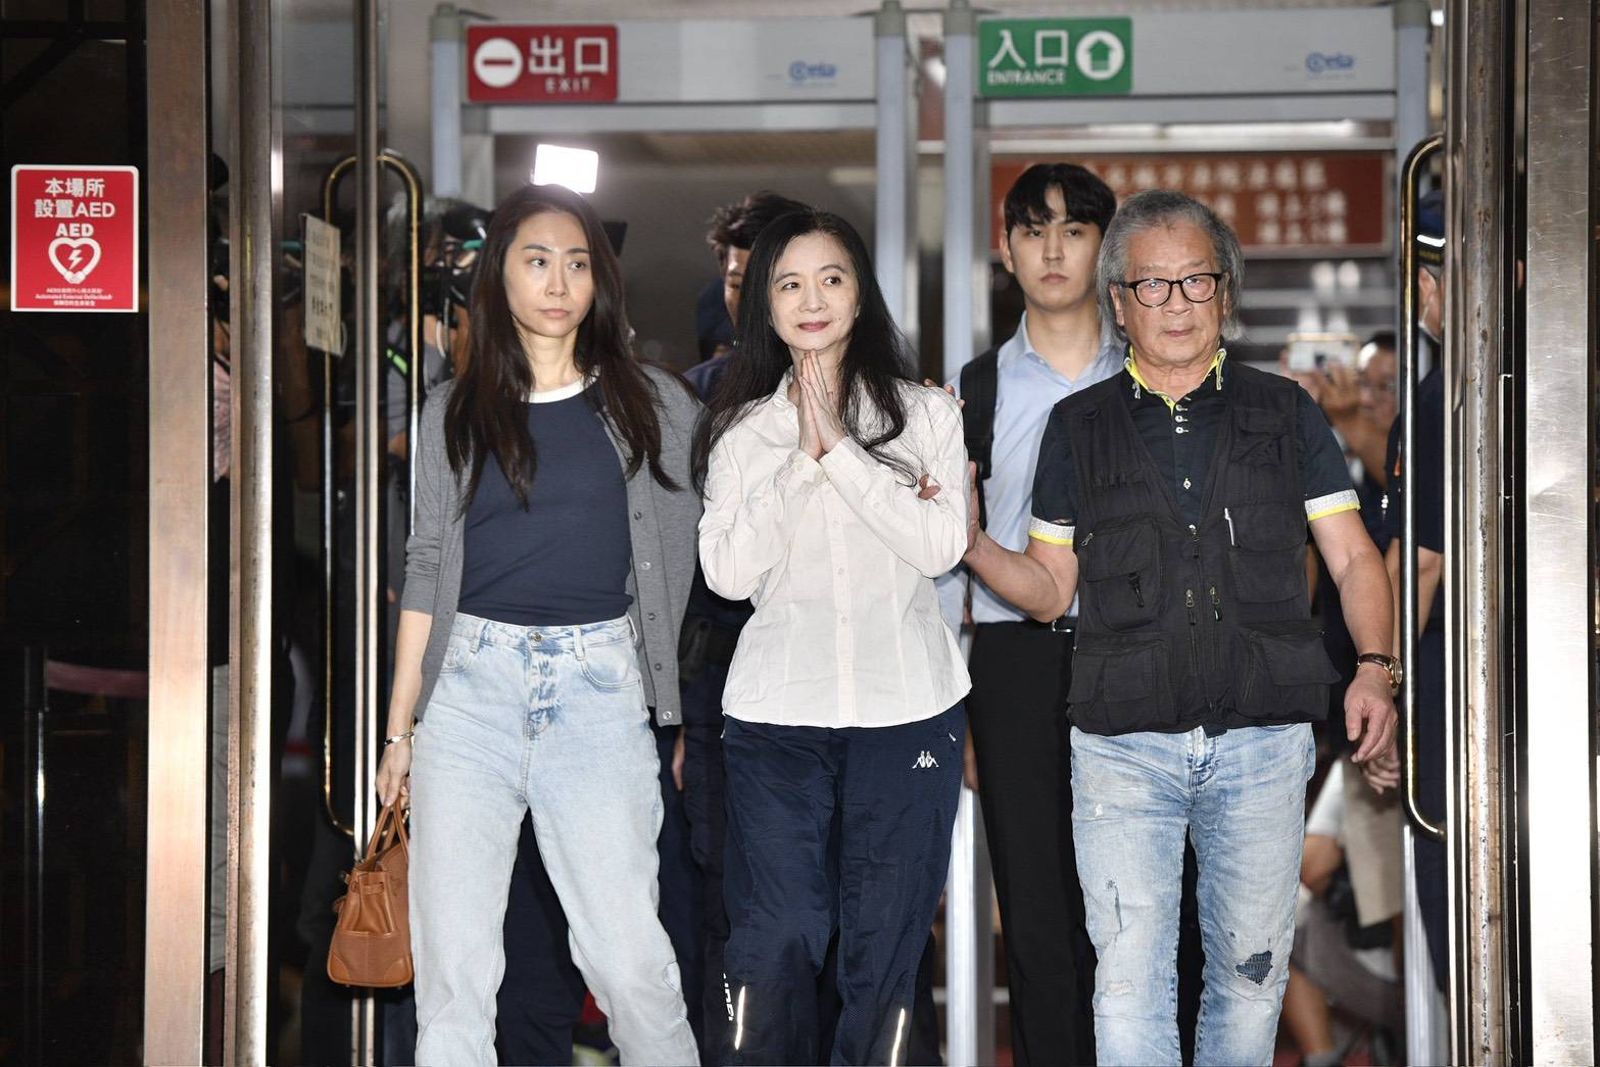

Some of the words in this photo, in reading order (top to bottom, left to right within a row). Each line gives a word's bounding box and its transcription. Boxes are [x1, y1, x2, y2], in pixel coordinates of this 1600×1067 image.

[528, 34, 608, 75] 出口
[988, 29, 1068, 68] 入口
[545, 77, 591, 94] EXIT
[987, 69, 1066, 85] ENTRANCE
[45, 177, 105, 198] 本場所
[34, 199, 115, 218] 設置AED
[56, 223, 94, 237] AED
